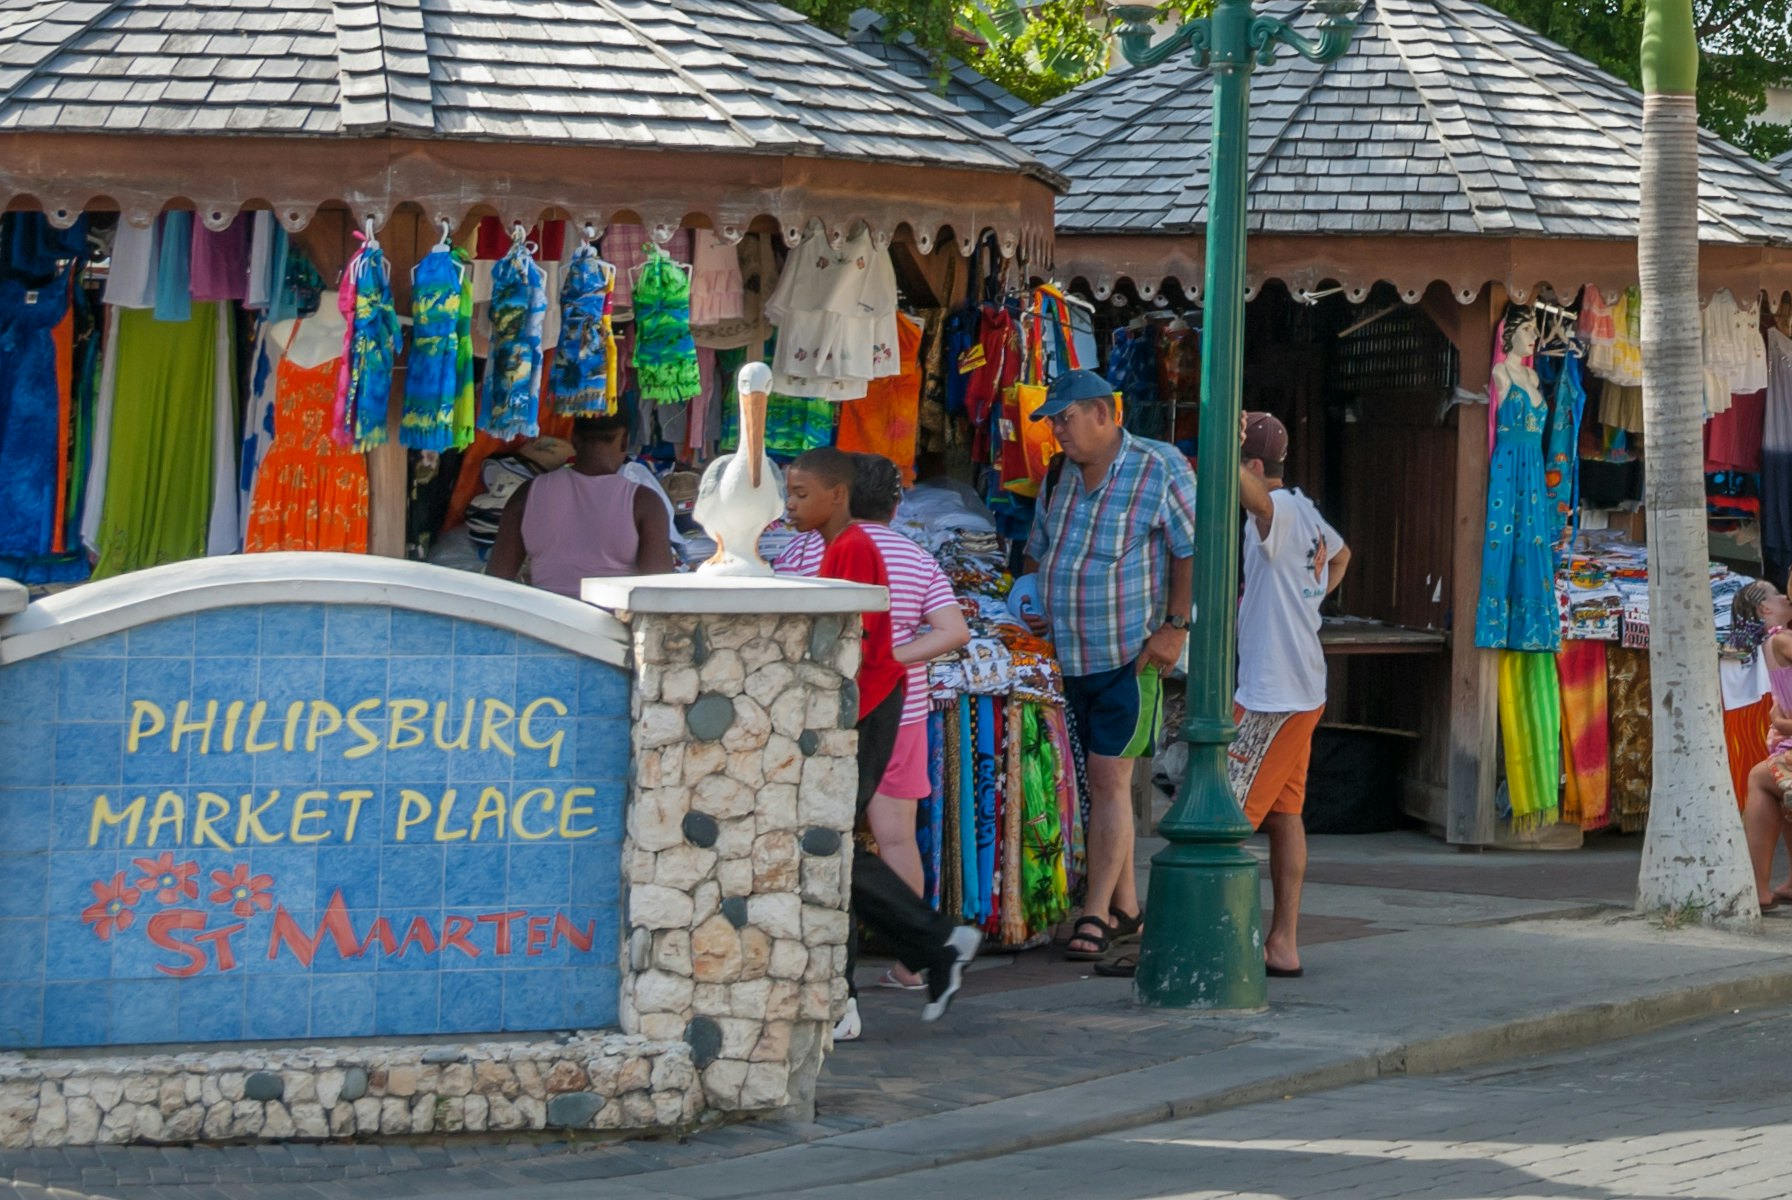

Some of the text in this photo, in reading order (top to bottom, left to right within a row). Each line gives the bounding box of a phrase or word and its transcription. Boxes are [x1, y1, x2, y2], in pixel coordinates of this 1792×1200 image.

[128, 698, 567, 767] PHILIPSBURG
[89, 786, 597, 851] MARKET PLACE
[268, 889, 596, 967] MAARTEN
